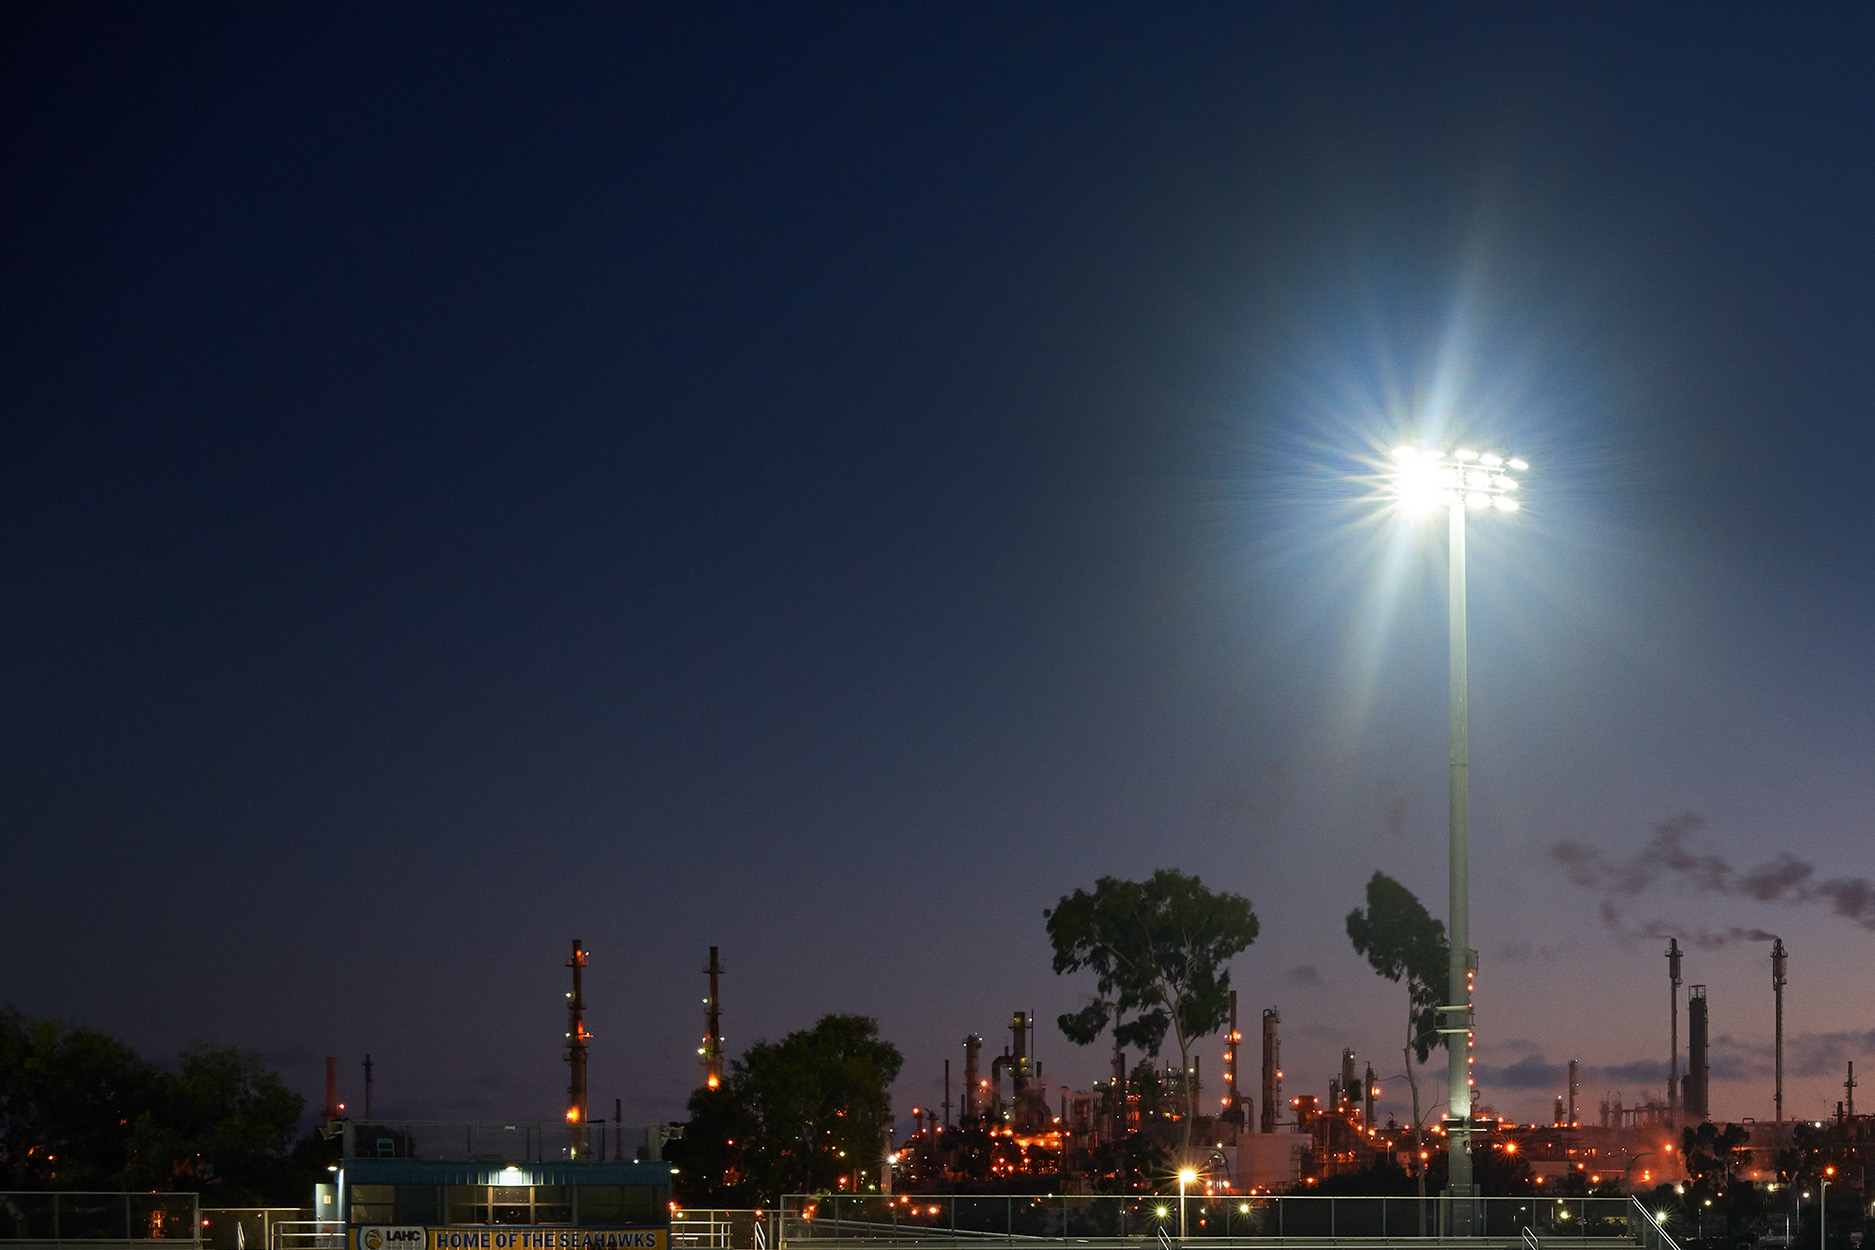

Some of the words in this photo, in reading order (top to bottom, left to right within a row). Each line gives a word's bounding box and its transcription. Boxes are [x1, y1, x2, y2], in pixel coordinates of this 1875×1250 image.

[386, 1231, 421, 1241] LAHC
[437, 1232, 490, 1248] HOME
[495, 1232, 518, 1248] OF
[521, 1231, 555, 1248] THE
[559, 1231, 657, 1249] SEAHAWKS
